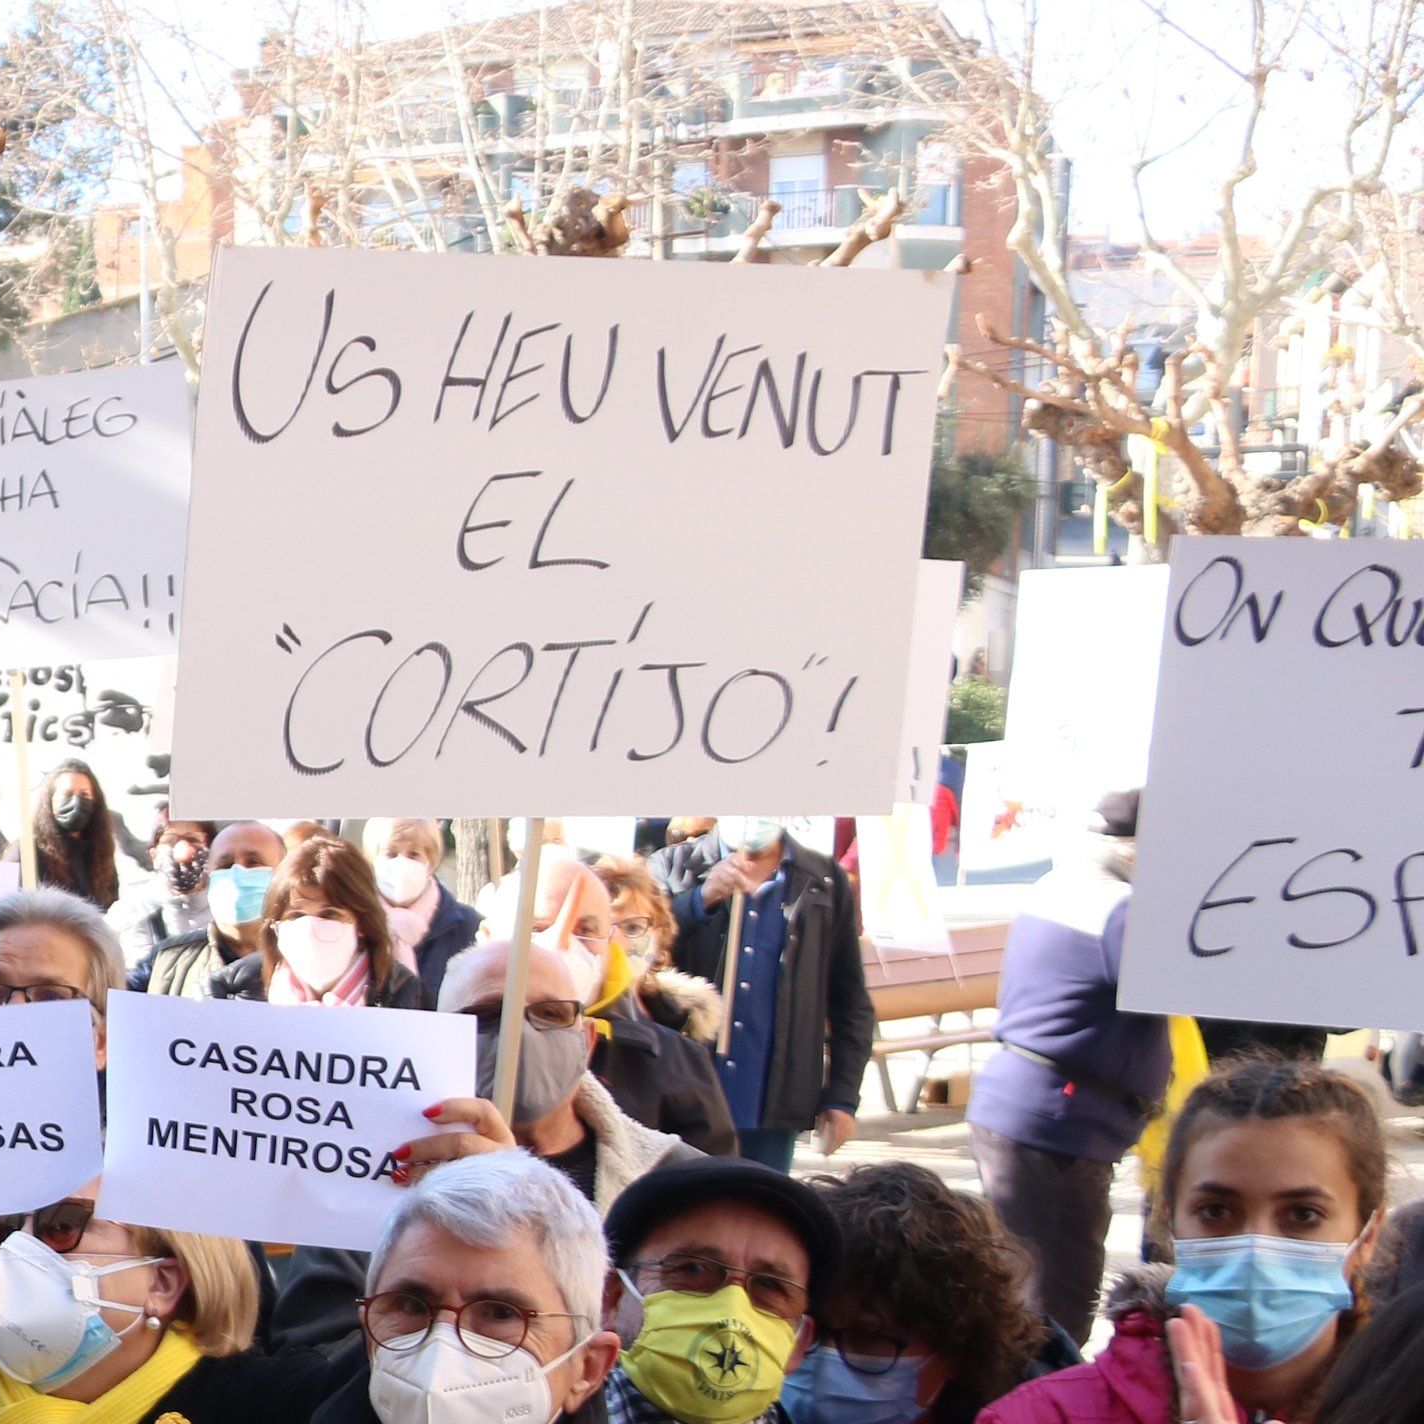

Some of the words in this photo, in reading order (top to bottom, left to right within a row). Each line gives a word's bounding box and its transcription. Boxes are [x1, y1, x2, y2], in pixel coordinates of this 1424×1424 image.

[433, 310, 620, 432] HEU
[657, 333, 930, 457] VENUT
[456, 470, 611, 571] EL
[1174, 554, 1285, 648] ON
[167, 1037, 421, 1092] CASANDRA
[227, 1086, 354, 1130] ROSA
